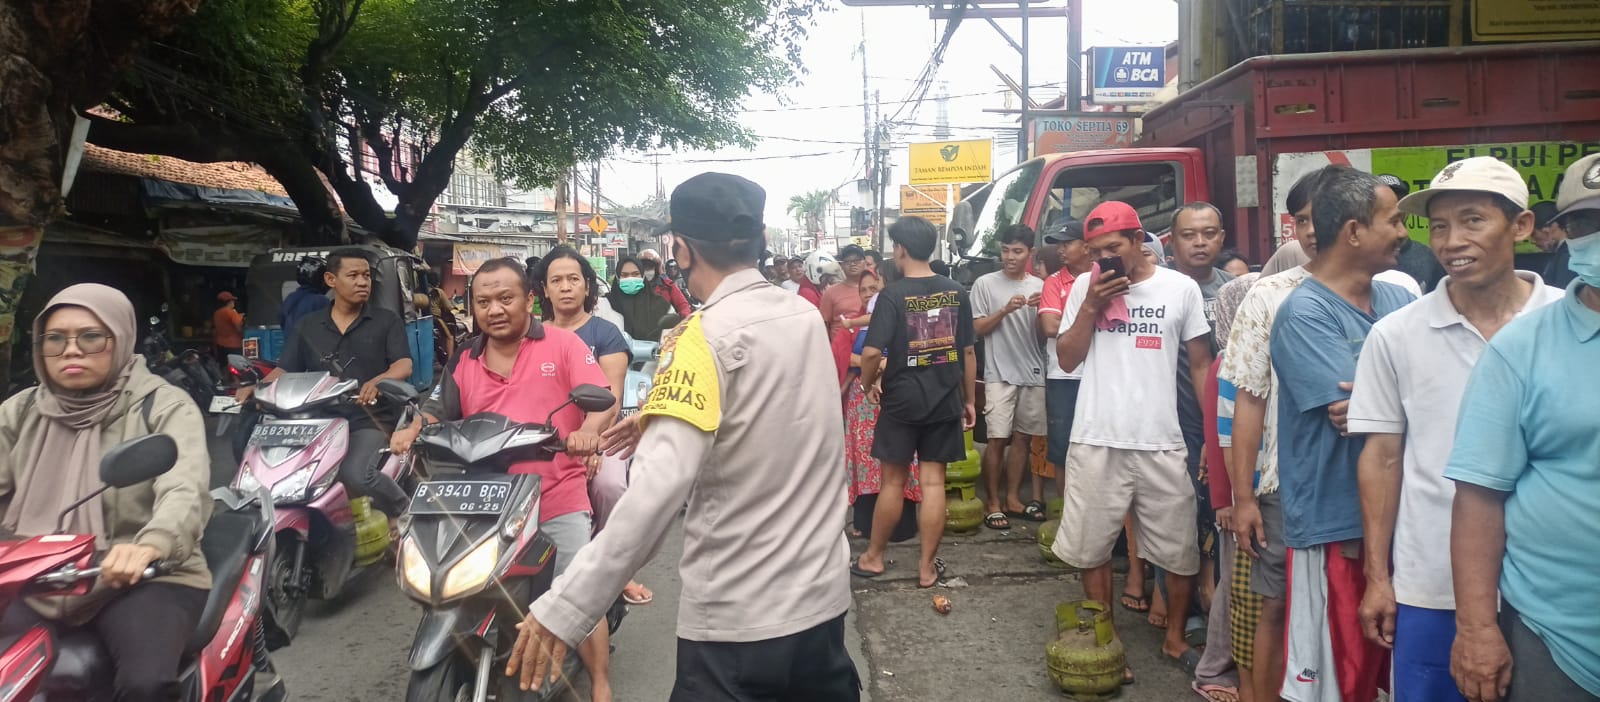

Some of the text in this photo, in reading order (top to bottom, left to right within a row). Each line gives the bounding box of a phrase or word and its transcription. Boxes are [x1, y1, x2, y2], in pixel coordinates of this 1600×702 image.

[1122, 52, 1152, 65] ATM
[1130, 68, 1159, 81] BCA
[1043, 121, 1128, 132] TOKO SEPTIA 69
[905, 294, 960, 313] ARGAL
[417, 485, 507, 498] B 3940 BCR
